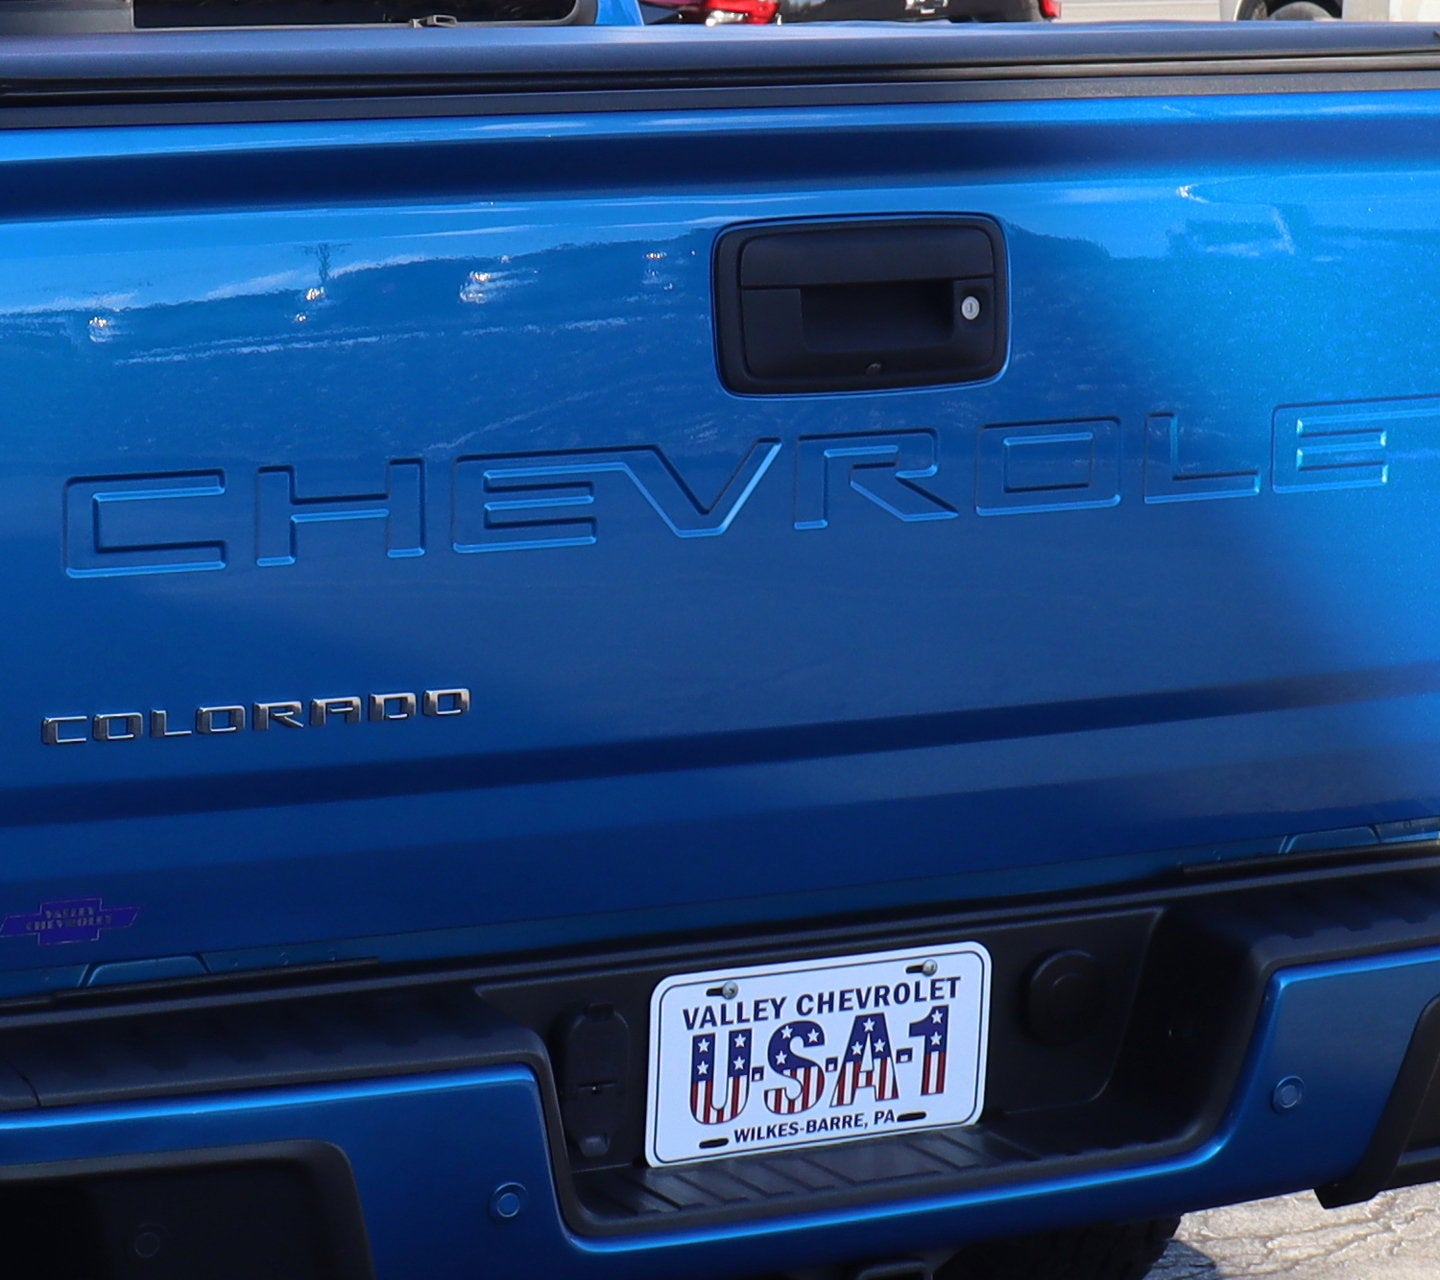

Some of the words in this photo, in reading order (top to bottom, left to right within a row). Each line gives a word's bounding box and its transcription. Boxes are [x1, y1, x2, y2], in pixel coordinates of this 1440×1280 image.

[41, 687, 471, 745] COLORADO
[682, 995, 787, 1032] VALLEY
[796, 976, 962, 1017] CHEVROLET
[733, 1113, 869, 1144] WILKES-BARRE,
[874, 1110, 896, 1127] PA
